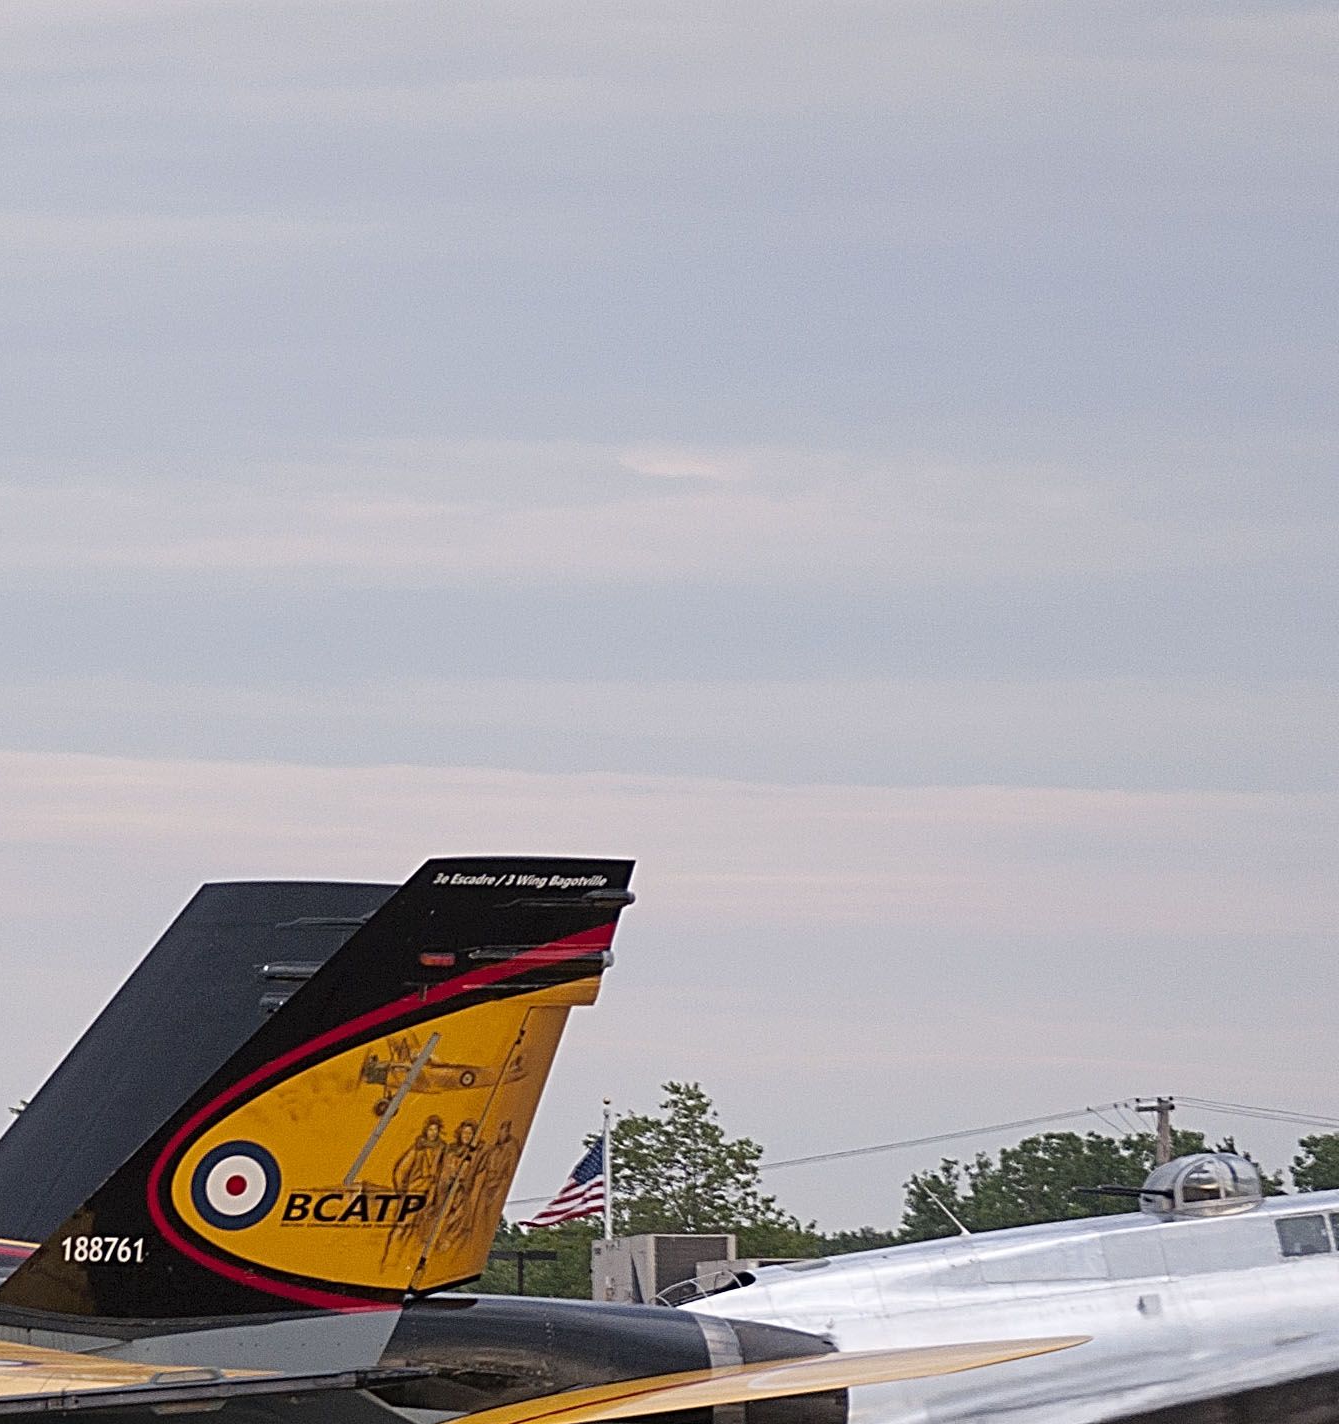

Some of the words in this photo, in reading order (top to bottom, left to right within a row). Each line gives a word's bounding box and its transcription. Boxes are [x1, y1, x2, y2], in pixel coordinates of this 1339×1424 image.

[450, 873, 496, 886] Escadre
[505, 874, 516, 886] 3
[516, 874, 548, 889] Wing
[548, 874, 608, 889] Bagotville
[282, 1193, 427, 1222] BCATP
[61, 1236, 144, 1263] 188761
